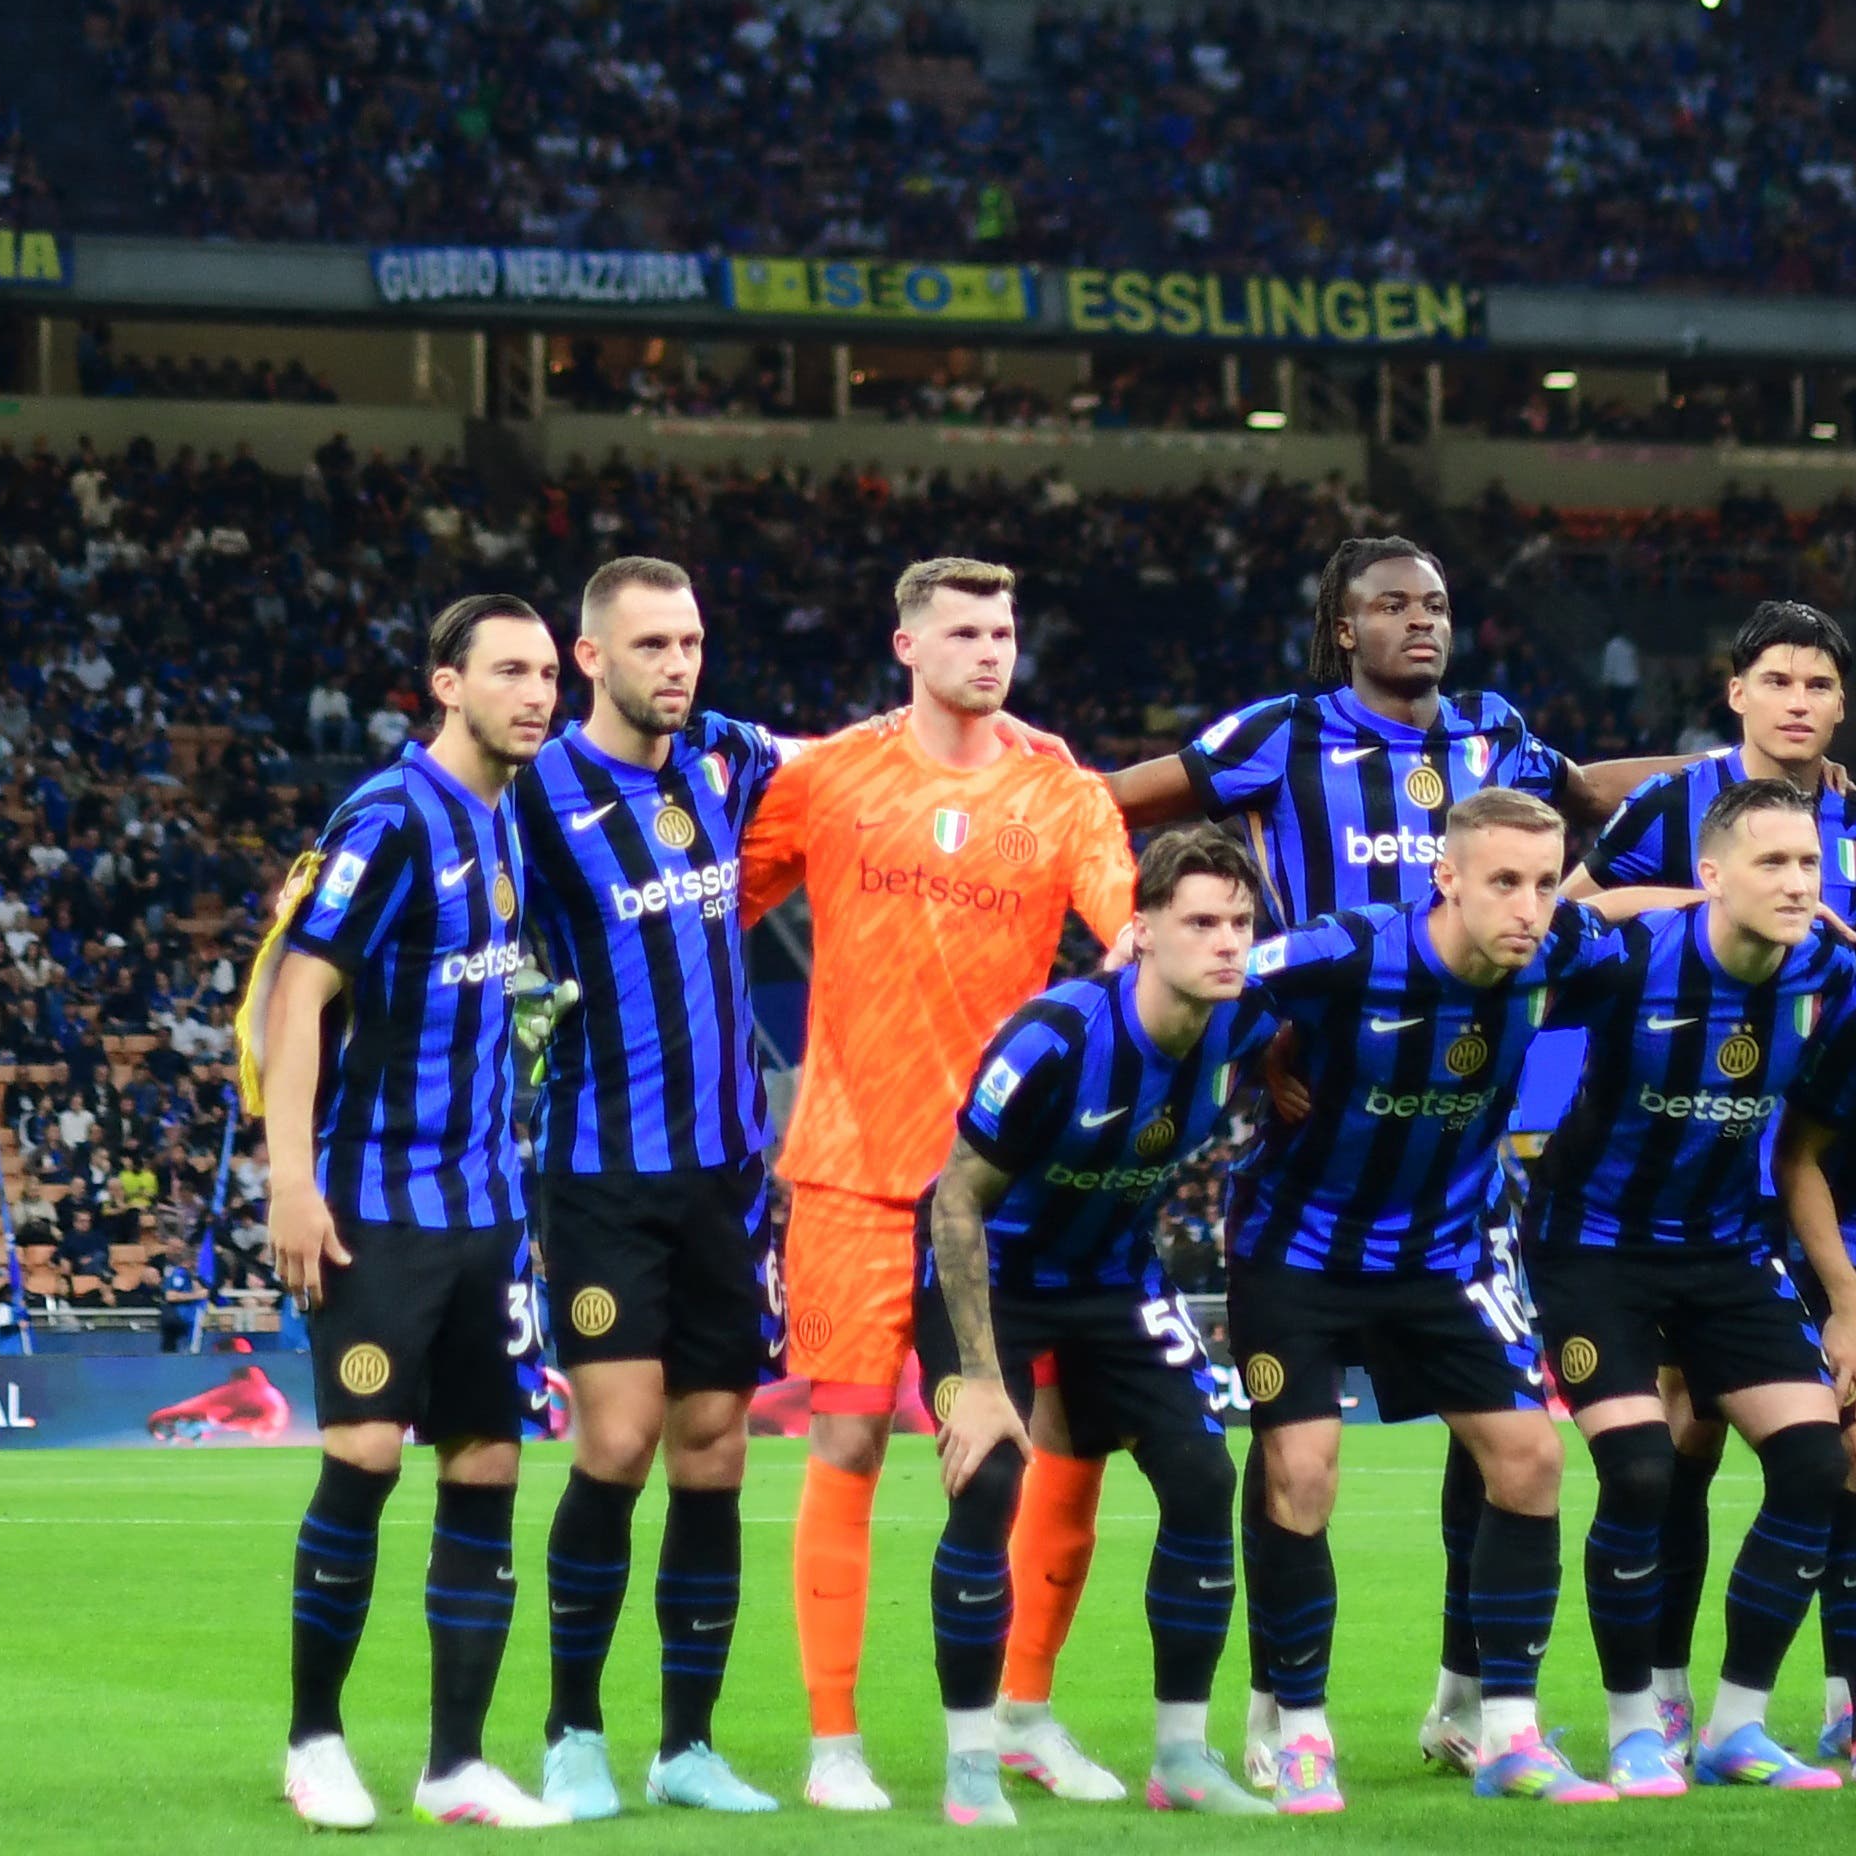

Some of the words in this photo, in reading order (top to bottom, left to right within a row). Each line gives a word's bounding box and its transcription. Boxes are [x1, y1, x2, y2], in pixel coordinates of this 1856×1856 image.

[1066, 268, 1467, 339] ESSLINGEN
[860, 858, 1022, 915] betsson
[1638, 1082, 1776, 1122] betsso
